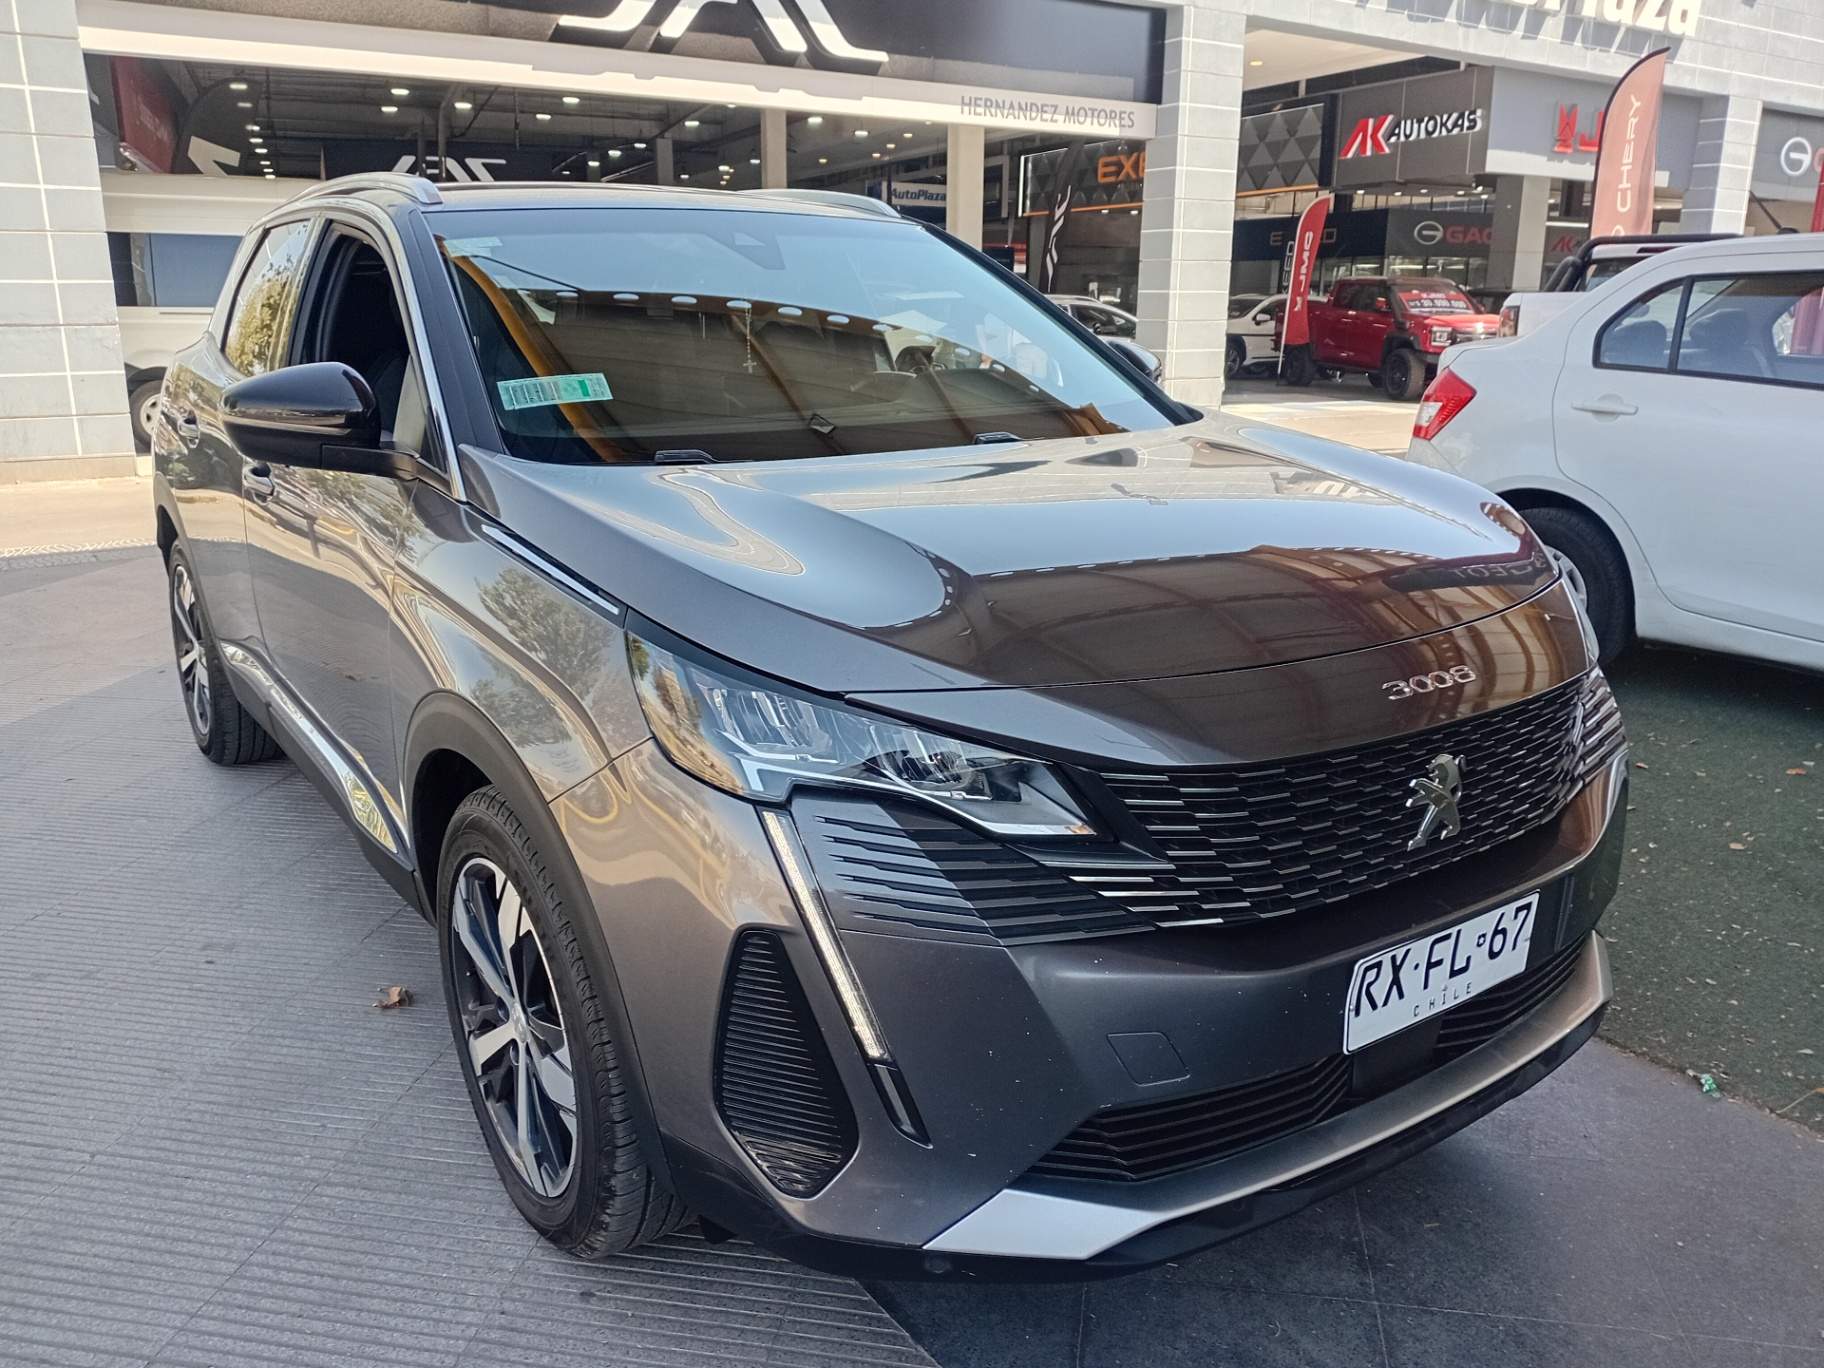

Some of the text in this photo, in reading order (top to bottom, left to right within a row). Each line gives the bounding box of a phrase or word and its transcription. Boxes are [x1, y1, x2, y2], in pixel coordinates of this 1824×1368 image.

[960, 95, 1136, 129] HERNANDEZ MOTORES
[1387, 108, 1482, 143] AUTOKAS
[1616, 94, 1642, 214] CHERY
[1382, 665, 1476, 700] 3008
[1413, 982, 1472, 1018] CHILE
